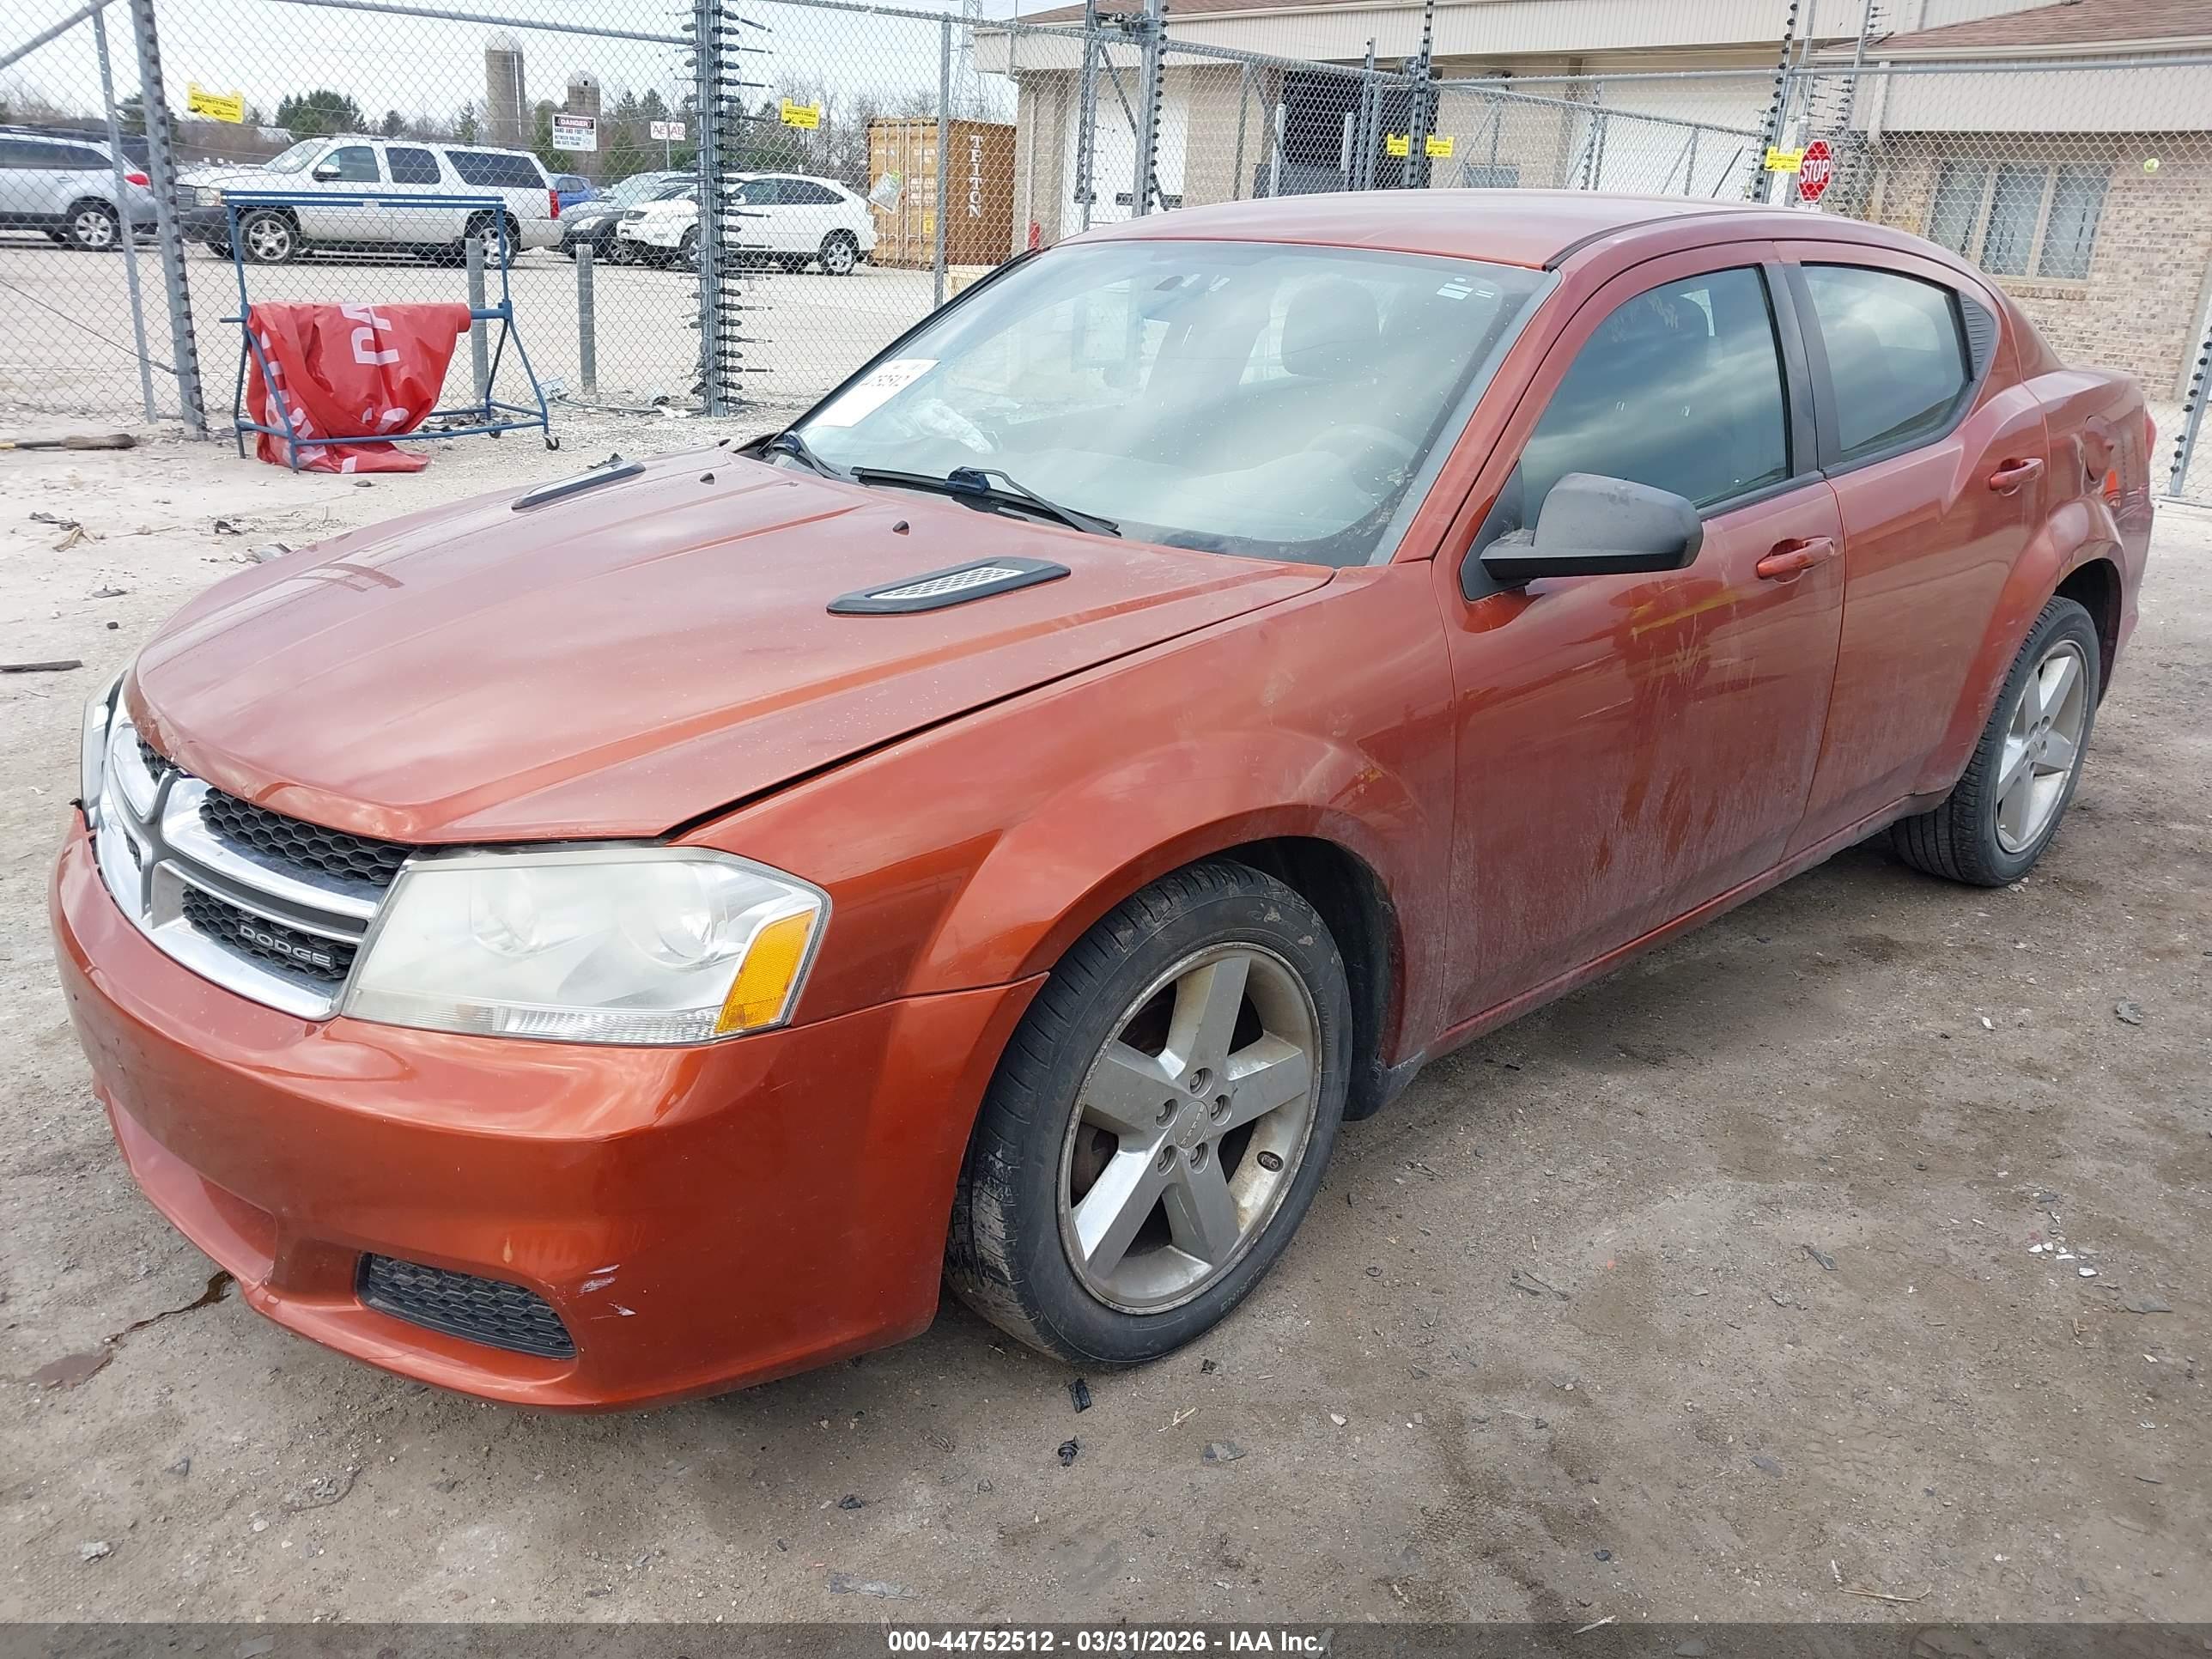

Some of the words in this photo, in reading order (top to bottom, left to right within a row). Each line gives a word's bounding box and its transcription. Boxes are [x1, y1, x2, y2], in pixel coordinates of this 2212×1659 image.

[560, 118, 589, 128] DANGER
[1801, 159, 1830, 183] STOP
[240, 924, 331, 968] DODGE
